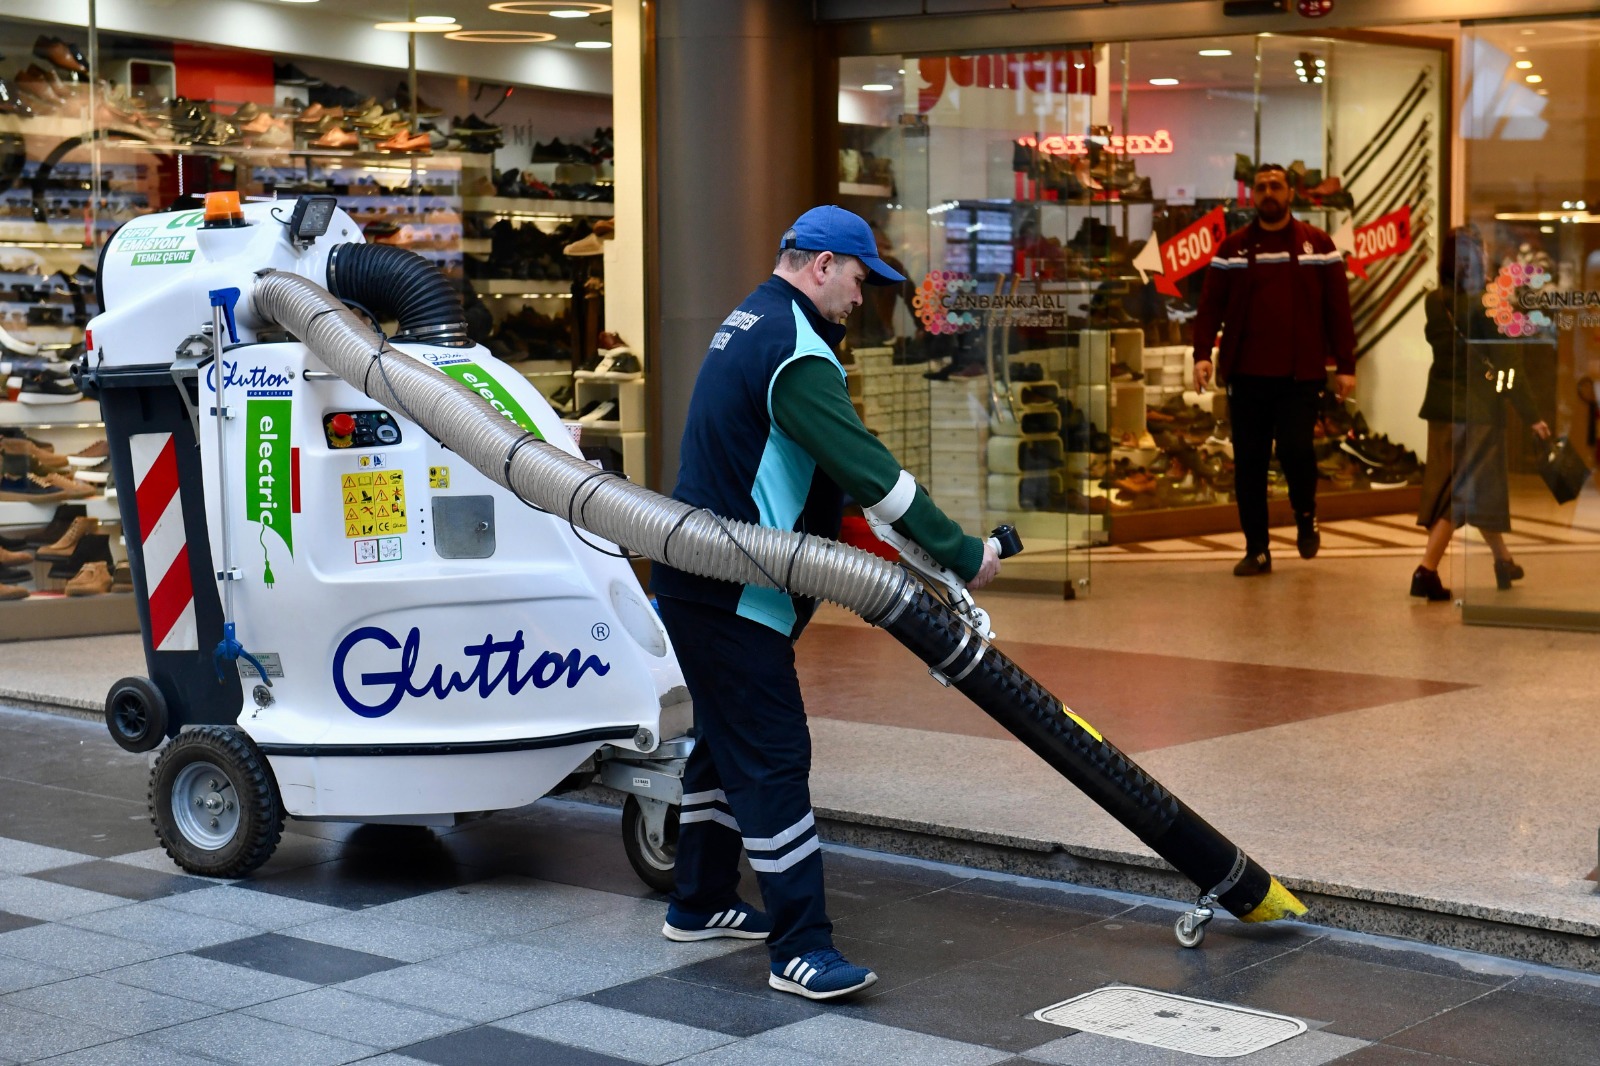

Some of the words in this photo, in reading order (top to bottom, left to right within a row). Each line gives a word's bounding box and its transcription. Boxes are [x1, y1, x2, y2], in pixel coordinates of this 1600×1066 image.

[162, 251, 190, 264] ÇEVRE
[1166, 226, 1212, 272] 1500
[1356, 221, 1397, 259] 2000
[206, 360, 289, 392] Glutton
[258, 415, 278, 525] electric
[332, 626, 611, 719] Glutton
